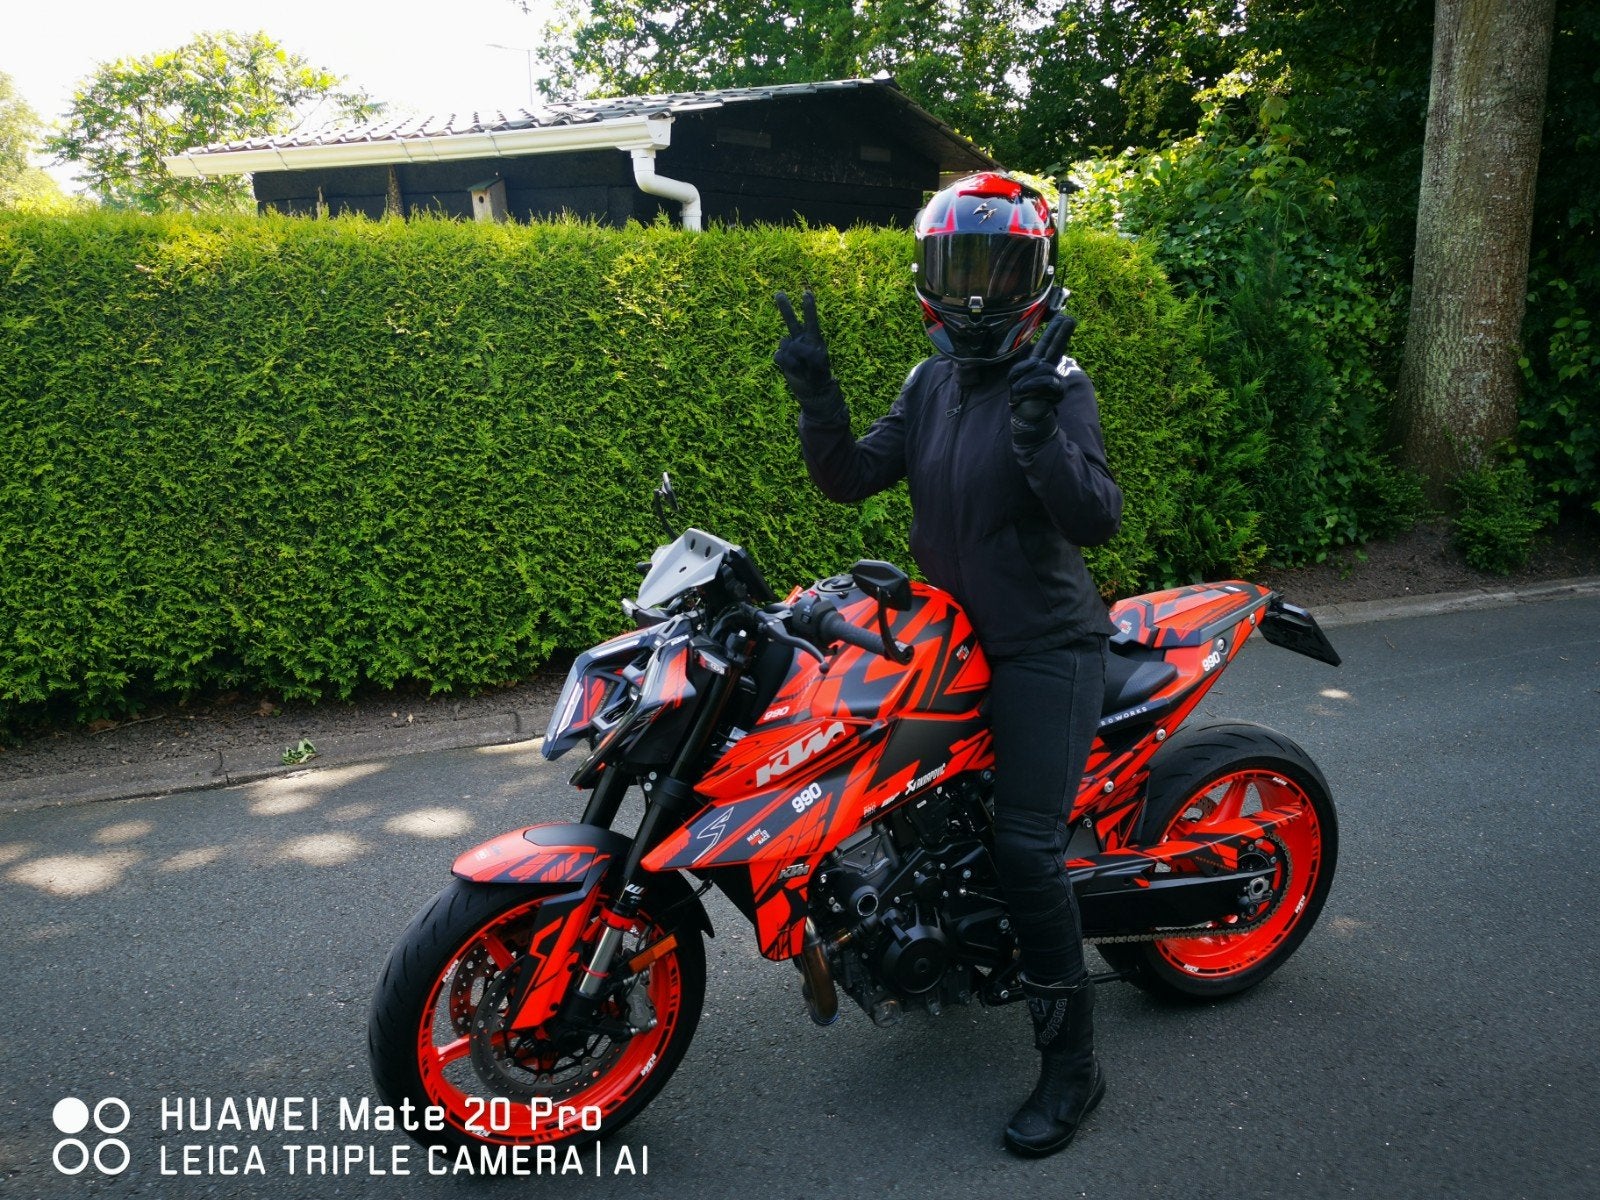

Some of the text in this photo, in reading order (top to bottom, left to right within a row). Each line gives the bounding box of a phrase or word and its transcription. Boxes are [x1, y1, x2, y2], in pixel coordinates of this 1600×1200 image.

[1202, 651, 1221, 672] 990
[763, 706, 790, 721] 990
[756, 721, 846, 788] KTM
[791, 782, 822, 813] 990
[778, 863, 810, 880] KTM
